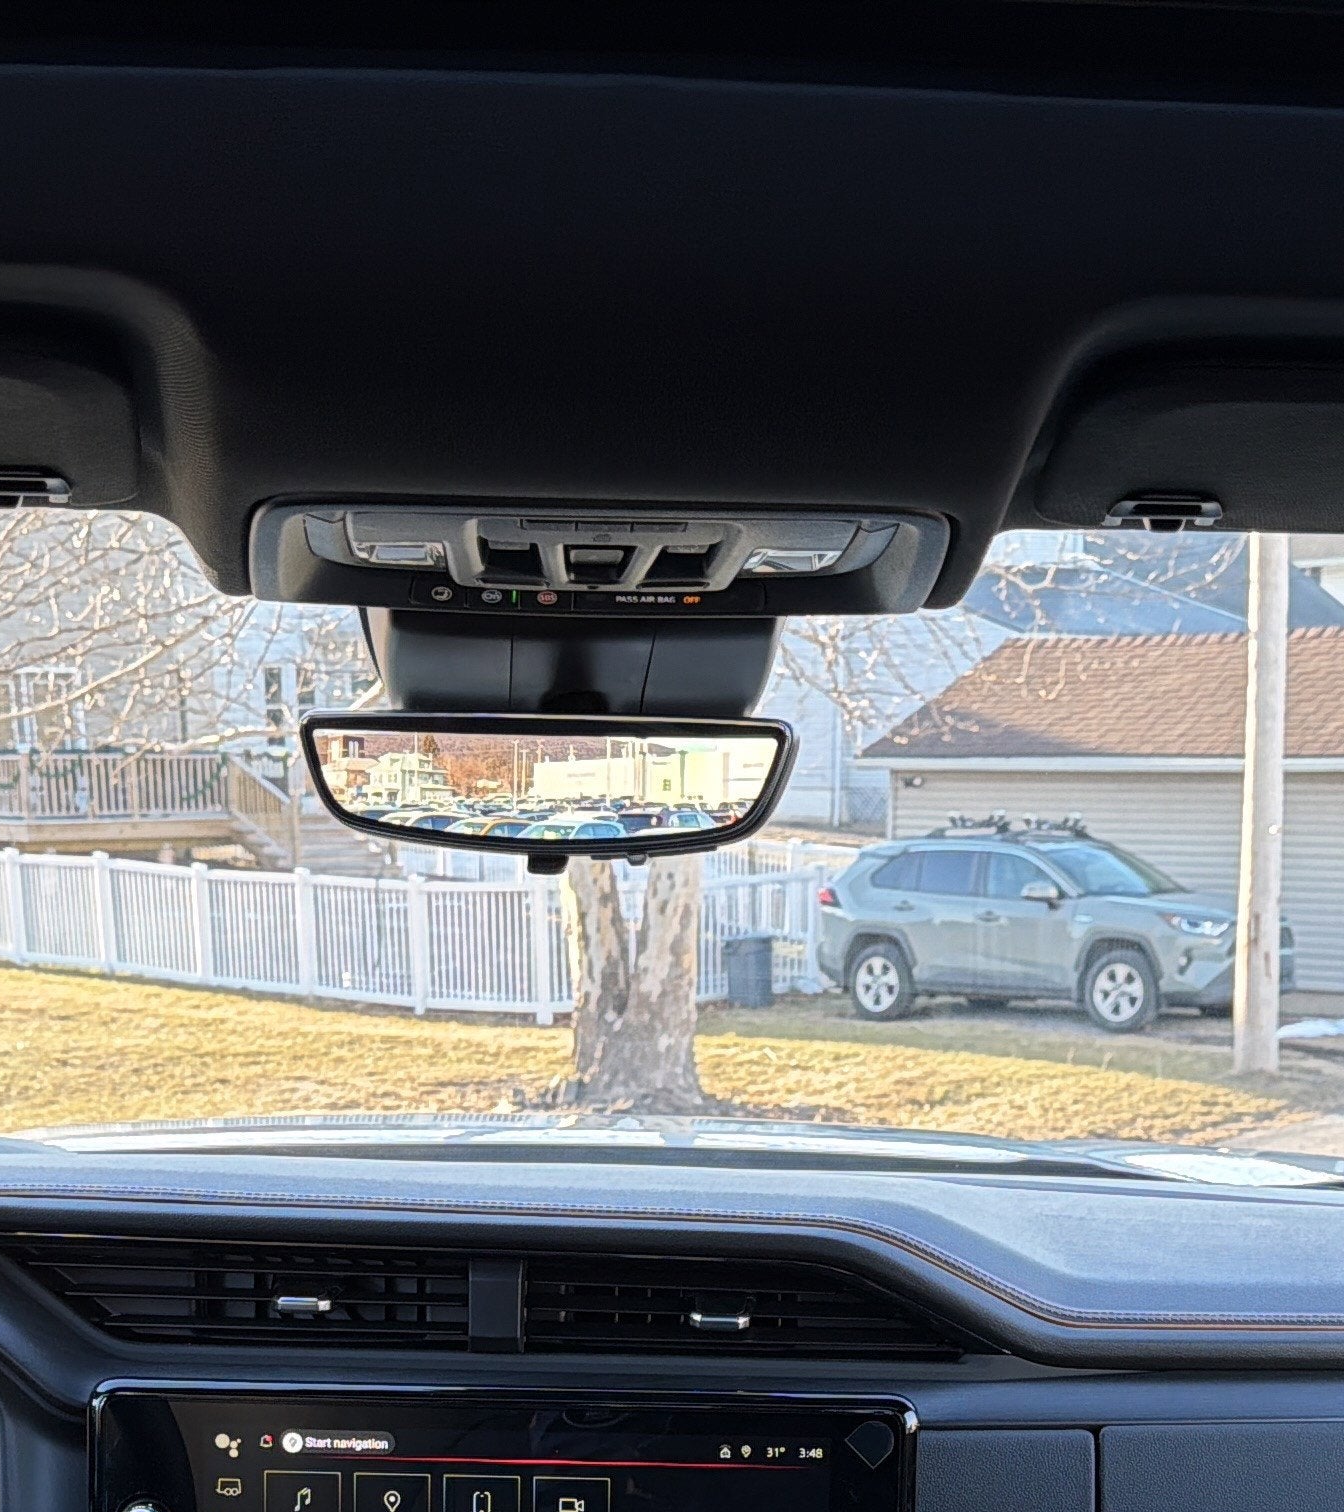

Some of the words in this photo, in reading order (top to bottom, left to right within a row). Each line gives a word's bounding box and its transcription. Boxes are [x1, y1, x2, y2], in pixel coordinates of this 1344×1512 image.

[615, 595, 638, 604] PASS
[640, 595, 655, 604] AIR
[683, 596, 701, 604] OFF
[304, 1436, 331, 1449] Start
[333, 1437, 389, 1452] navigation
[798, 1447, 823, 1459] 3:48
